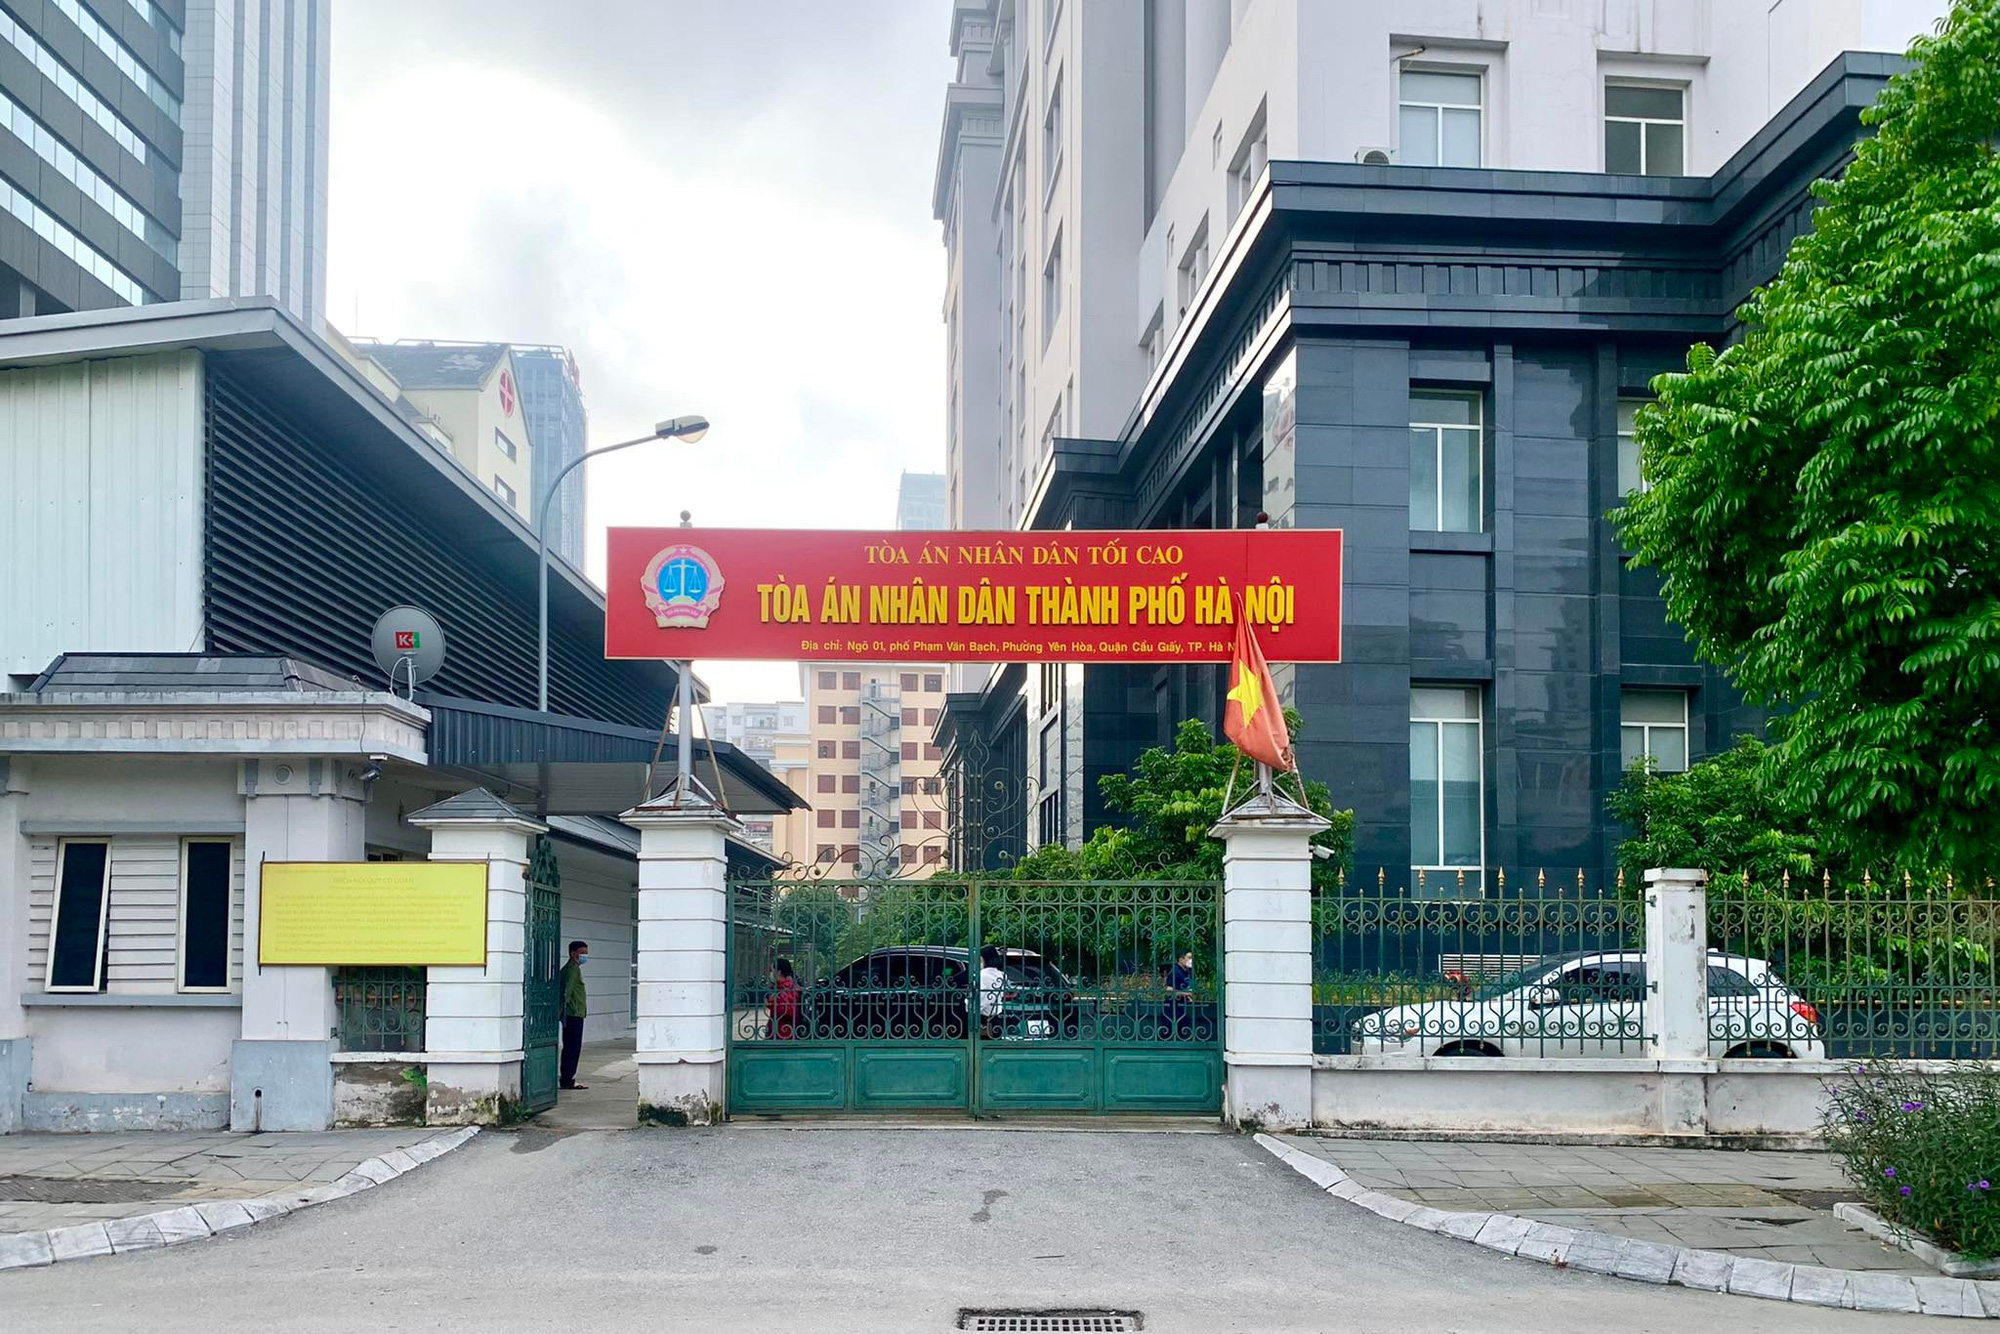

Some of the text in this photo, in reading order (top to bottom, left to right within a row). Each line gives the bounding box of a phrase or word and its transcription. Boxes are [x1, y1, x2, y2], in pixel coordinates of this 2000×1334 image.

[864, 538, 1184, 565] TÒA ÁN NHÂN DÂN TỐI CAO
[757, 572, 1295, 633] TÒA ÁN NHÂN DÂN THÀNH PHỐ HÀ NỘI
[801, 640, 819, 652] Địa
[847, 640, 868, 653] Ngõ
[873, 641, 886, 652] 01,
[890, 639, 911, 653] phố
[914, 641, 943, 653] Phạm
[946, 641, 966, 652] Văn
[969, 641, 999, 654] Bạch,
[1003, 640, 1043, 654] Phường
[1048, 641, 1067, 652] Yên
[1071, 641, 1096, 653] Hòa,
[1099, 641, 1127, 653] Quận
[1157, 640, 1184, 654] Giấy,
[1188, 641, 1206, 652] TP.
[1209, 641, 1224, 652] Hà
